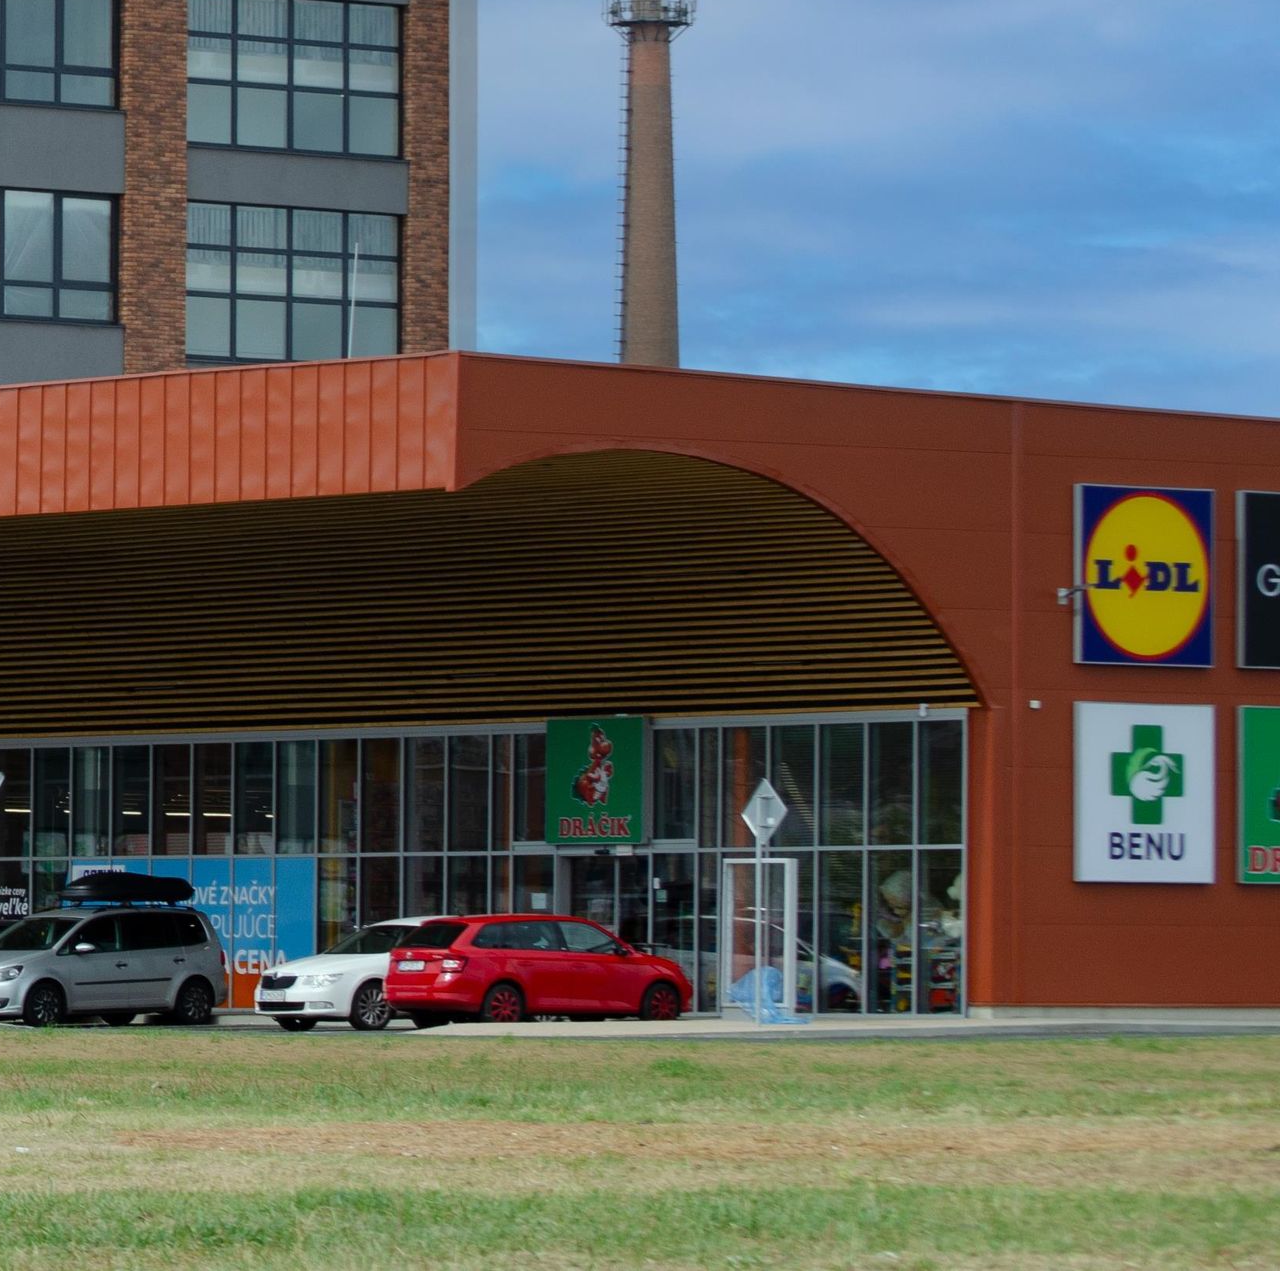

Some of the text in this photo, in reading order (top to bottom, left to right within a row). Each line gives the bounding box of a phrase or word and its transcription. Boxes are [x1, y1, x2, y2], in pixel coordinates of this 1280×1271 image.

[558, 811, 631, 839] DRÁČIK
[1108, 832, 1185, 861] BENU
[219, 880, 276, 905] ZNAČKY
[210, 908, 278, 938] PUJÚCE
